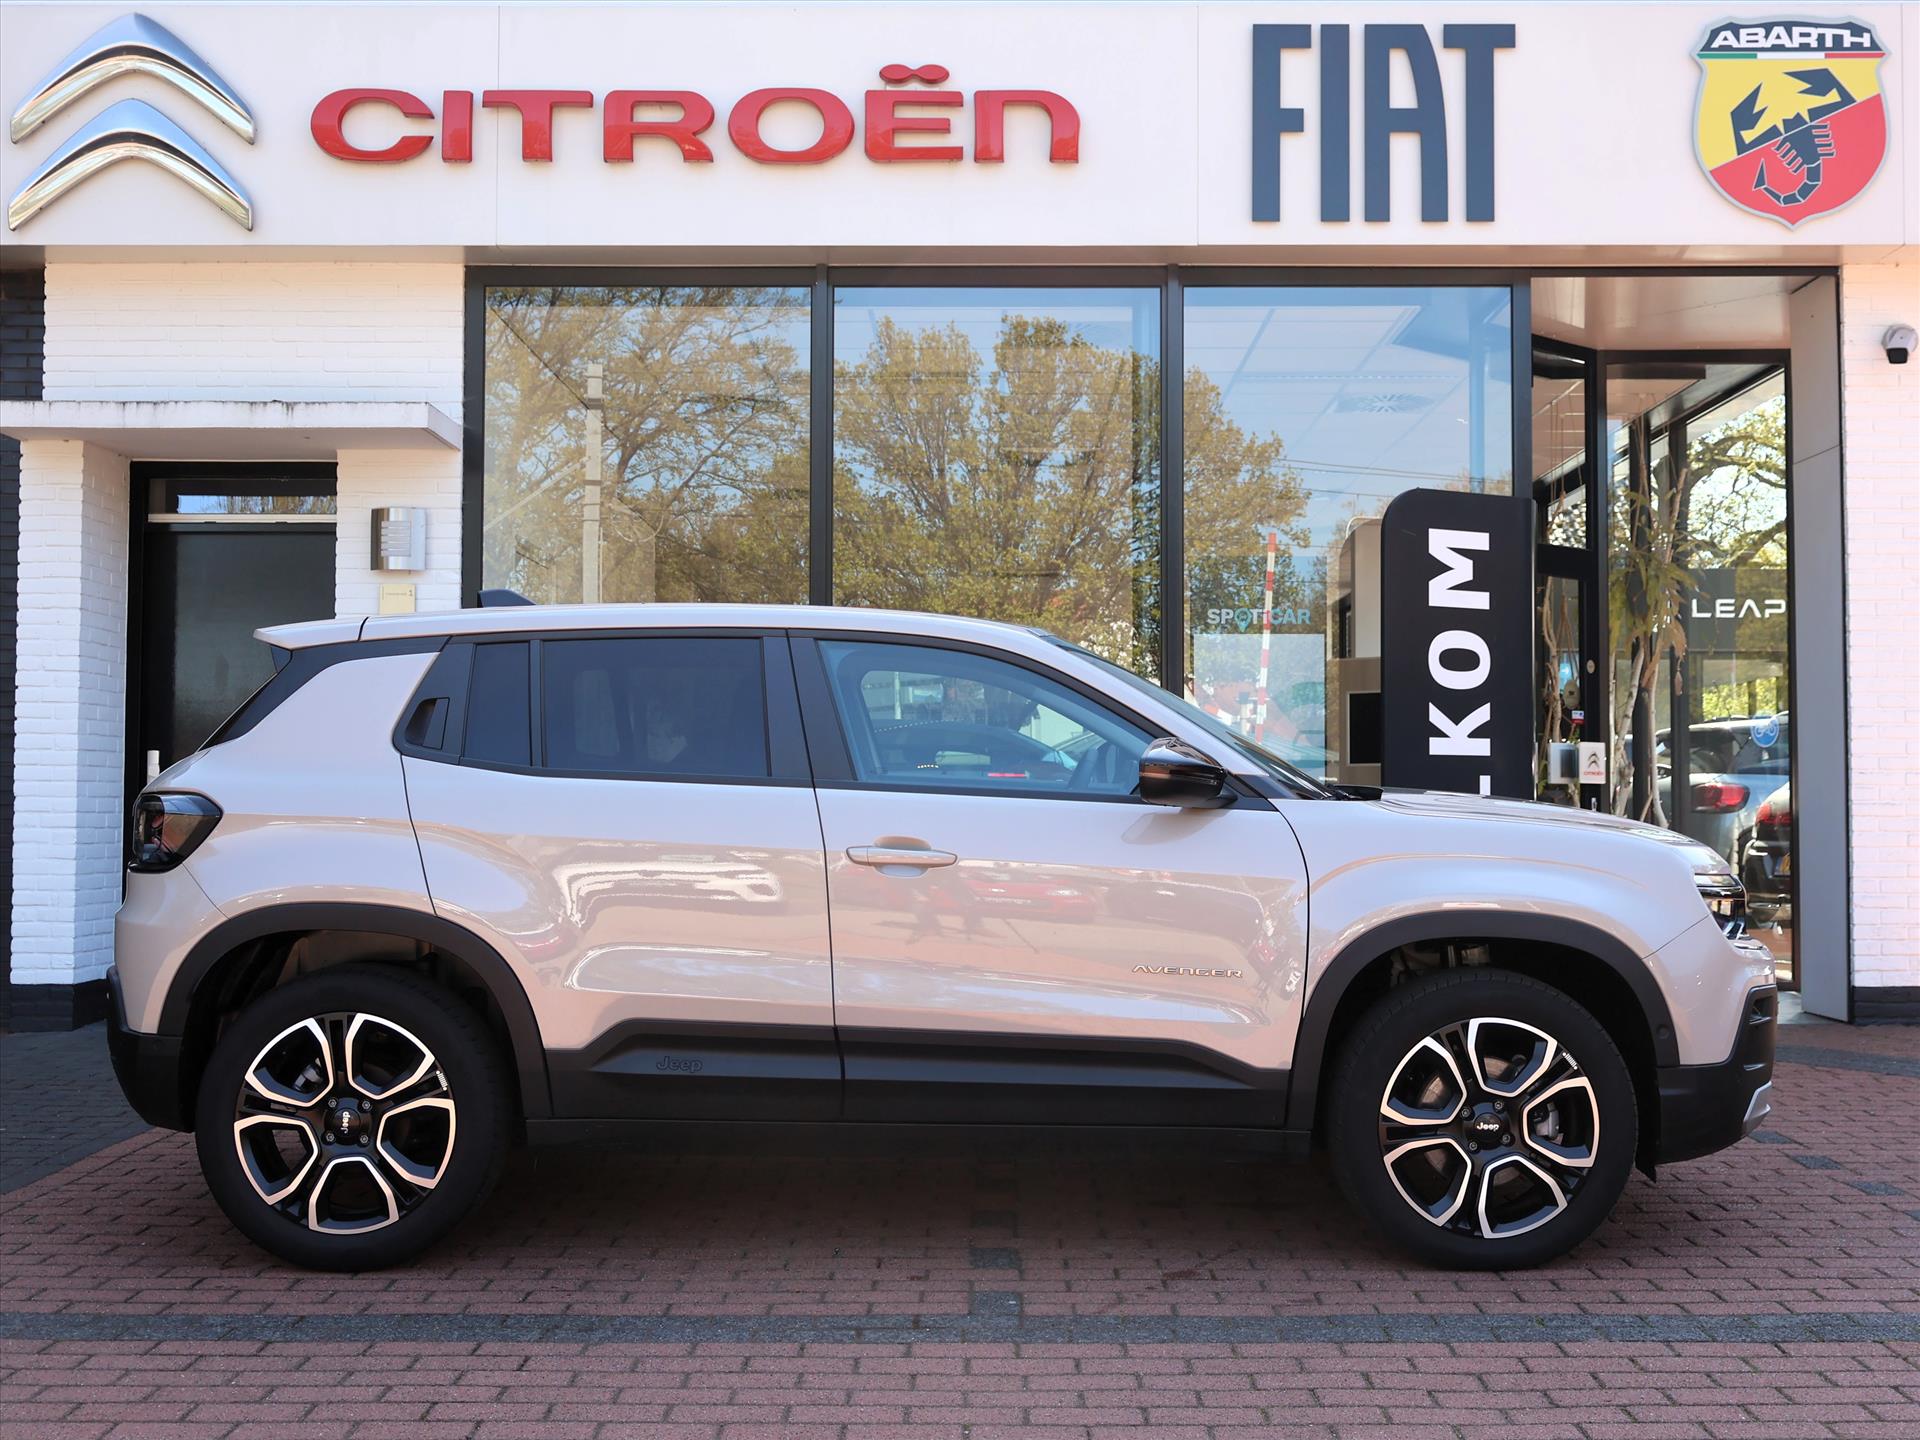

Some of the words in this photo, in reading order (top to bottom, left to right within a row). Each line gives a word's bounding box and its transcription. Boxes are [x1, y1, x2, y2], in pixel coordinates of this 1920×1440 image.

[1710, 26, 1871, 49] ABARTH
[310, 63, 1081, 164] CITROËN
[1252, 24, 1516, 222] FIAT
[1691, 598, 1786, 618] LEAP
[1132, 964, 1243, 979] AVENGER
[656, 1056, 704, 1073] Jeep
[340, 1111, 351, 1134] Jeep
[1476, 1121, 1500, 1132] Jeep
